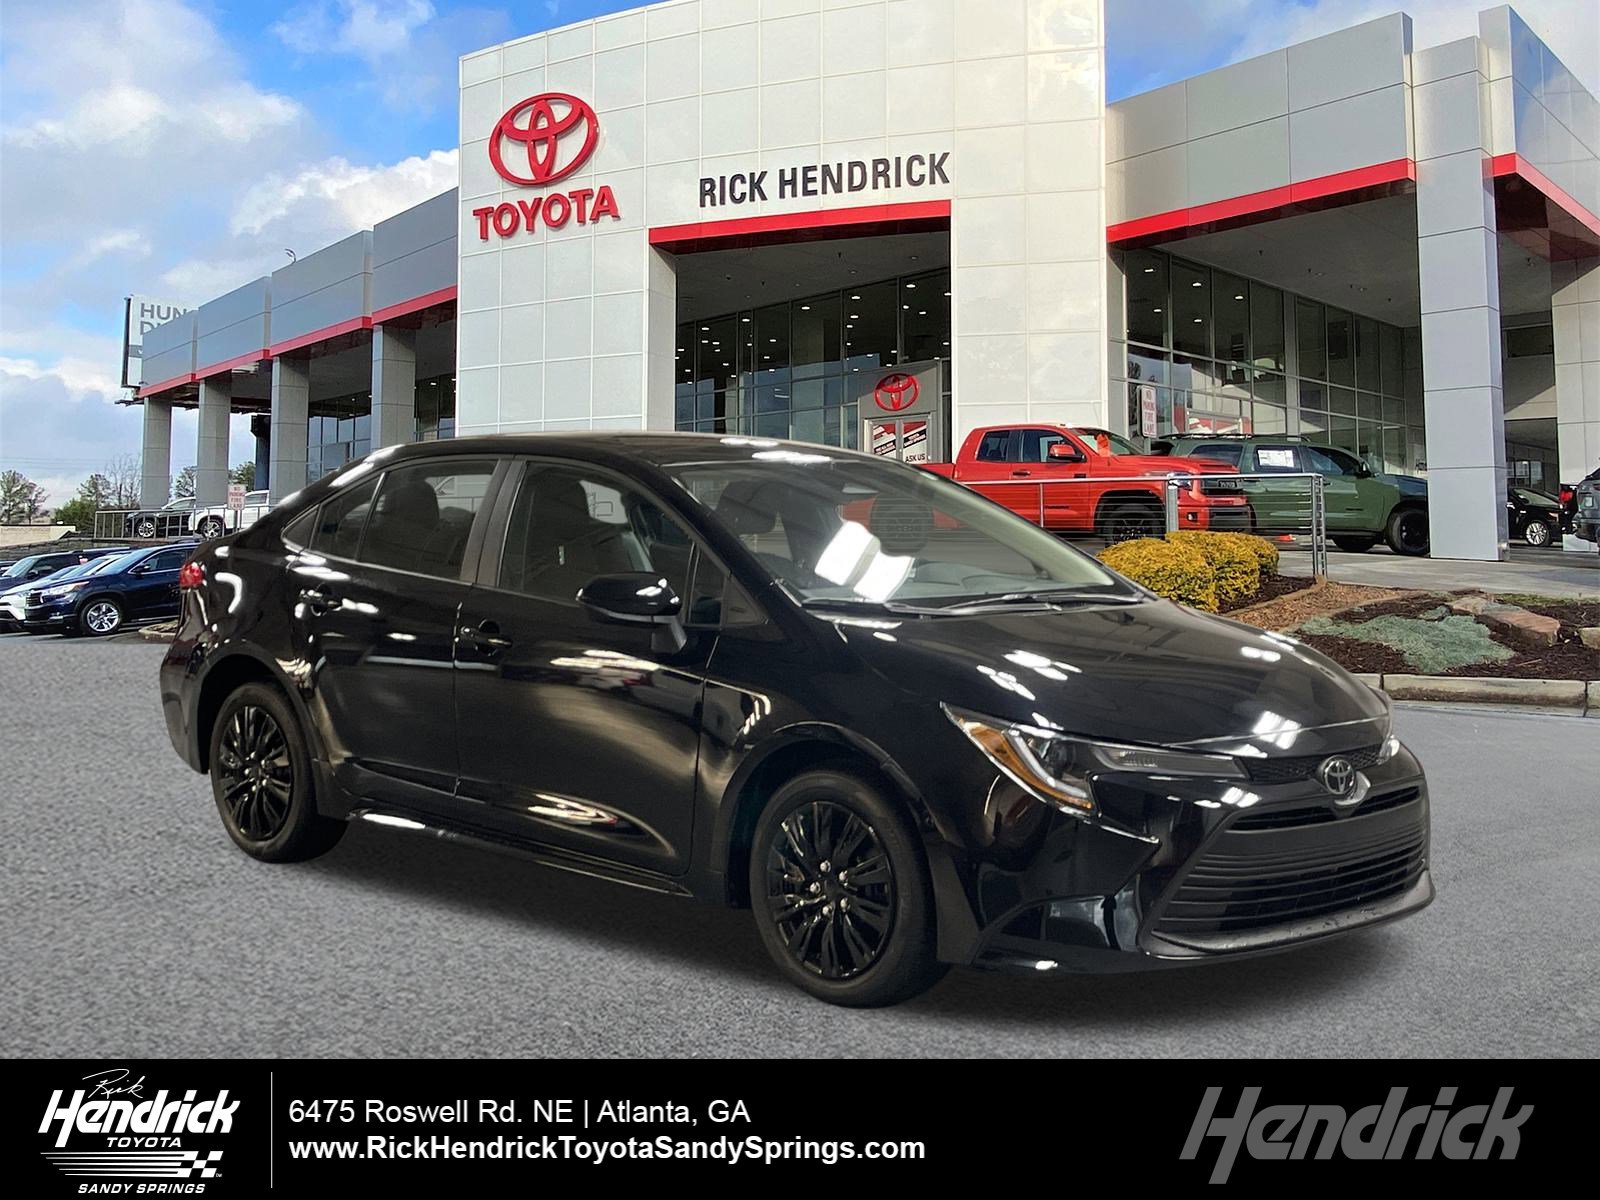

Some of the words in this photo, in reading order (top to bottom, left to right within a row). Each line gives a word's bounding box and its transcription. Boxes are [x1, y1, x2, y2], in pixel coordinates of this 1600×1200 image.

[699, 170, 768, 208] RICK
[778, 151, 950, 201] HENDRICK
[473, 186, 621, 240] TOYOTA
